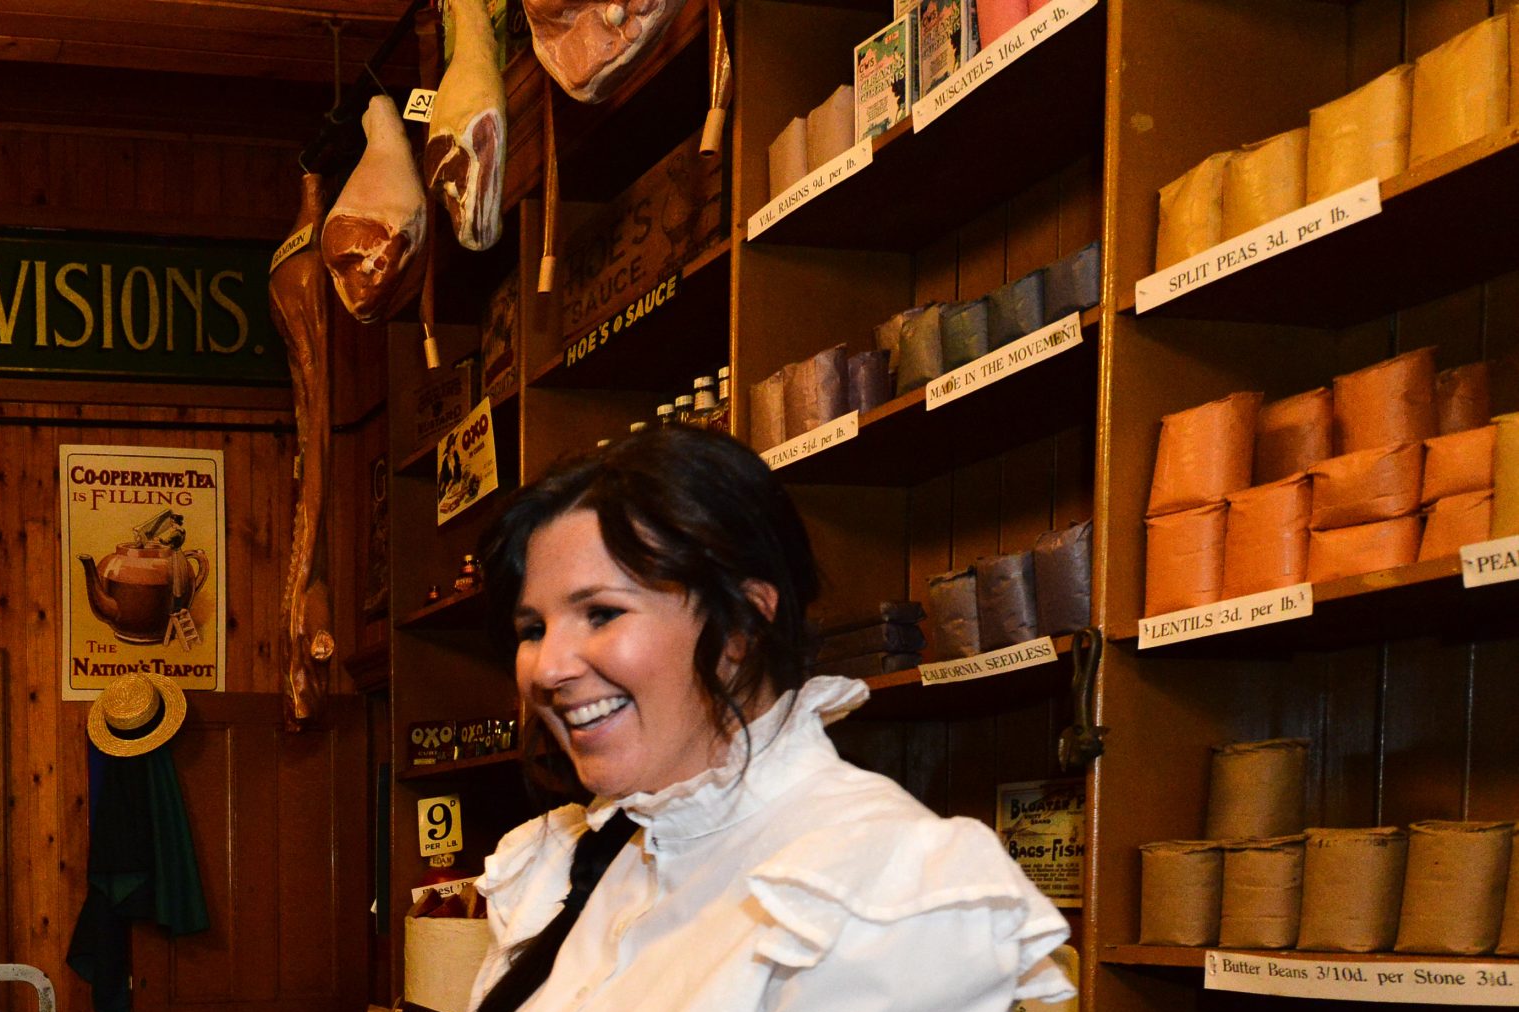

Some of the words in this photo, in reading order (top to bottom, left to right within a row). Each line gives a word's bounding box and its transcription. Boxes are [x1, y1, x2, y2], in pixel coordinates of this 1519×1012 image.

[934, 56, 994, 110] MUSCATELS
[998, 36, 1025, 61] 1/6d.
[1030, 19, 1049, 41] per
[759, 210, 776, 227] VAL.
[778, 185, 810, 214] RAISINS
[812, 176, 825, 190] 9d.
[829, 167, 842, 183] per
[846, 158, 857, 170] lb.
[1169, 261, 1210, 292] SPLIT
[1217, 242, 1258, 271] PEAS
[1266, 230, 1288, 250] 3d.
[1297, 218, 1322, 240] per
[1330, 206, 1349, 224] lb.
[566, 321, 609, 367] HOE'S
[625, 275, 677, 328] SAUCE
[929, 376, 961, 401] MADE
[965, 370, 976, 385] IN
[981, 357, 1004, 378] THE
[1008, 324, 1077, 366] MOVEMENT
[462, 413, 489, 451] OXO
[821, 434, 833, 447] per
[836, 427, 845, 438] lb.
[70, 466, 184, 488] CO-OPERATIVE
[185, 470, 215, 489] TEA
[73, 492, 87, 502] IS
[90, 489, 193, 511] FILLING
[1477, 552, 1519, 574] PEA
[1151, 613, 1214, 640] LENTILS
[1221, 607, 1242, 625] 3d.
[1250, 603, 1274, 621] per
[1281, 596, 1298, 612] lb.
[86, 640, 117, 653] THE
[73, 657, 151, 676] NATION'S
[151, 659, 214, 677] TEAPOT
[923, 662, 982, 681] CALIFORNIA
[986, 644, 1051, 670] SEEDLESS
[411, 726, 453, 749] OXO
[427, 803, 452, 840] 9
[449, 799, 457, 807] D
[1010, 799, 1070, 820] BLOATER
[425, 843, 440, 851] PER
[1223, 959, 1260, 975] Butter
[1269, 962, 1308, 979] Beans
[1316, 966, 1367, 982] 3/10d.
[1378, 972, 1403, 988] per
[1415, 969, 1465, 986] Stone
